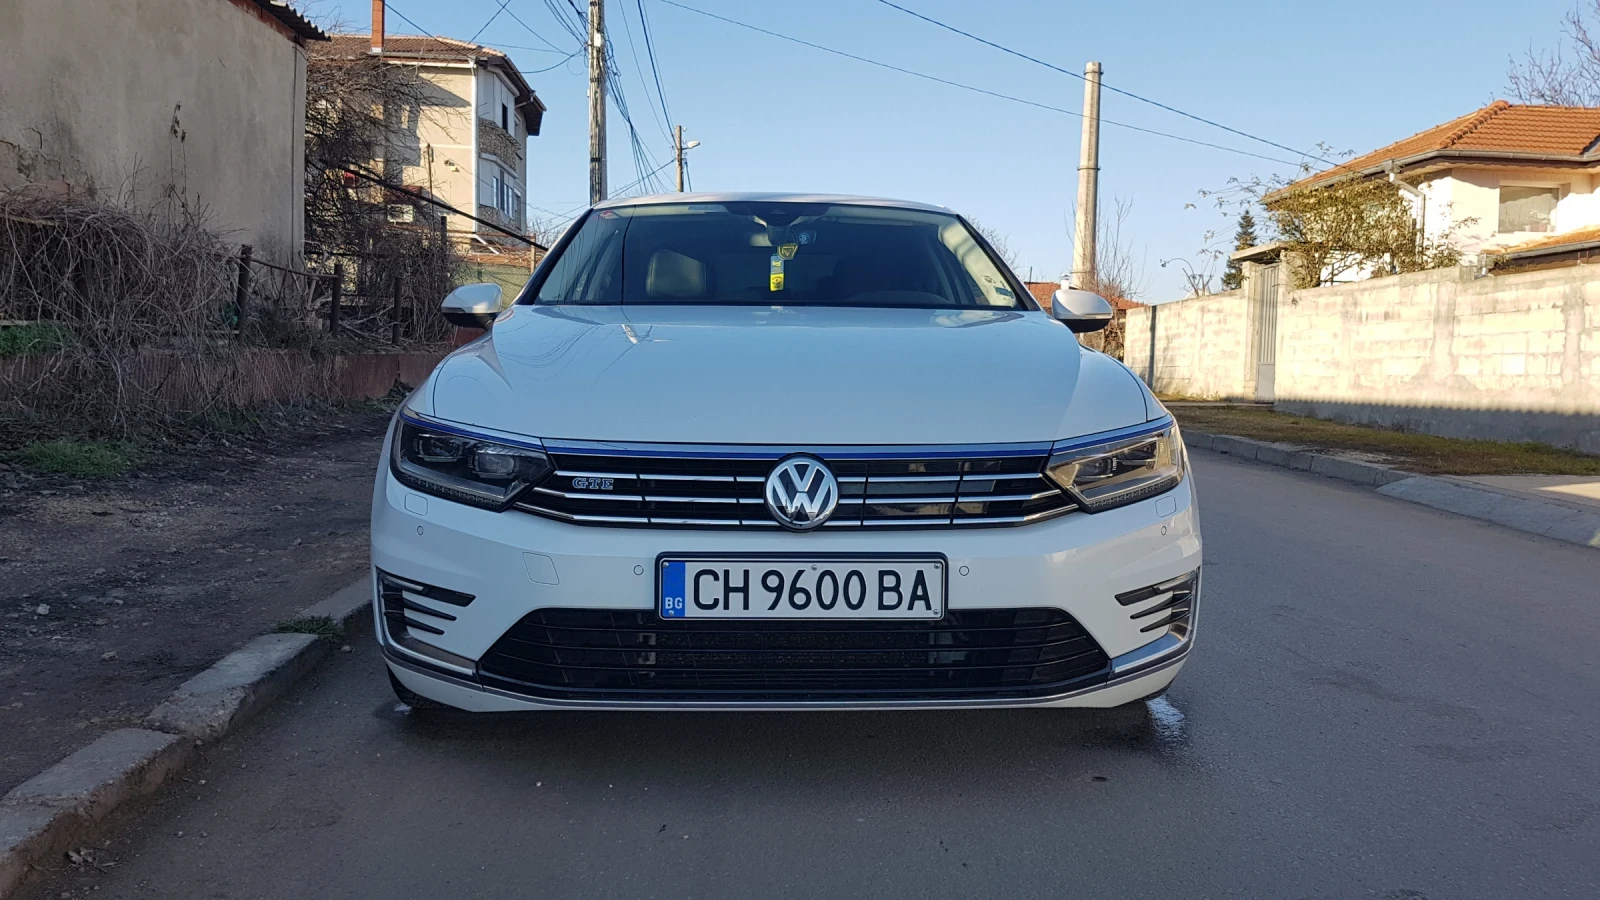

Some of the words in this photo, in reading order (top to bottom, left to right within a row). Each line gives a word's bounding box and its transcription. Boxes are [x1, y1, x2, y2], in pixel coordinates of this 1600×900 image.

[572, 477, 613, 490] GTE
[693, 568, 750, 610] CH
[760, 569, 867, 610] 9600
[877, 569, 932, 611] BA
[664, 596, 683, 609] BG
